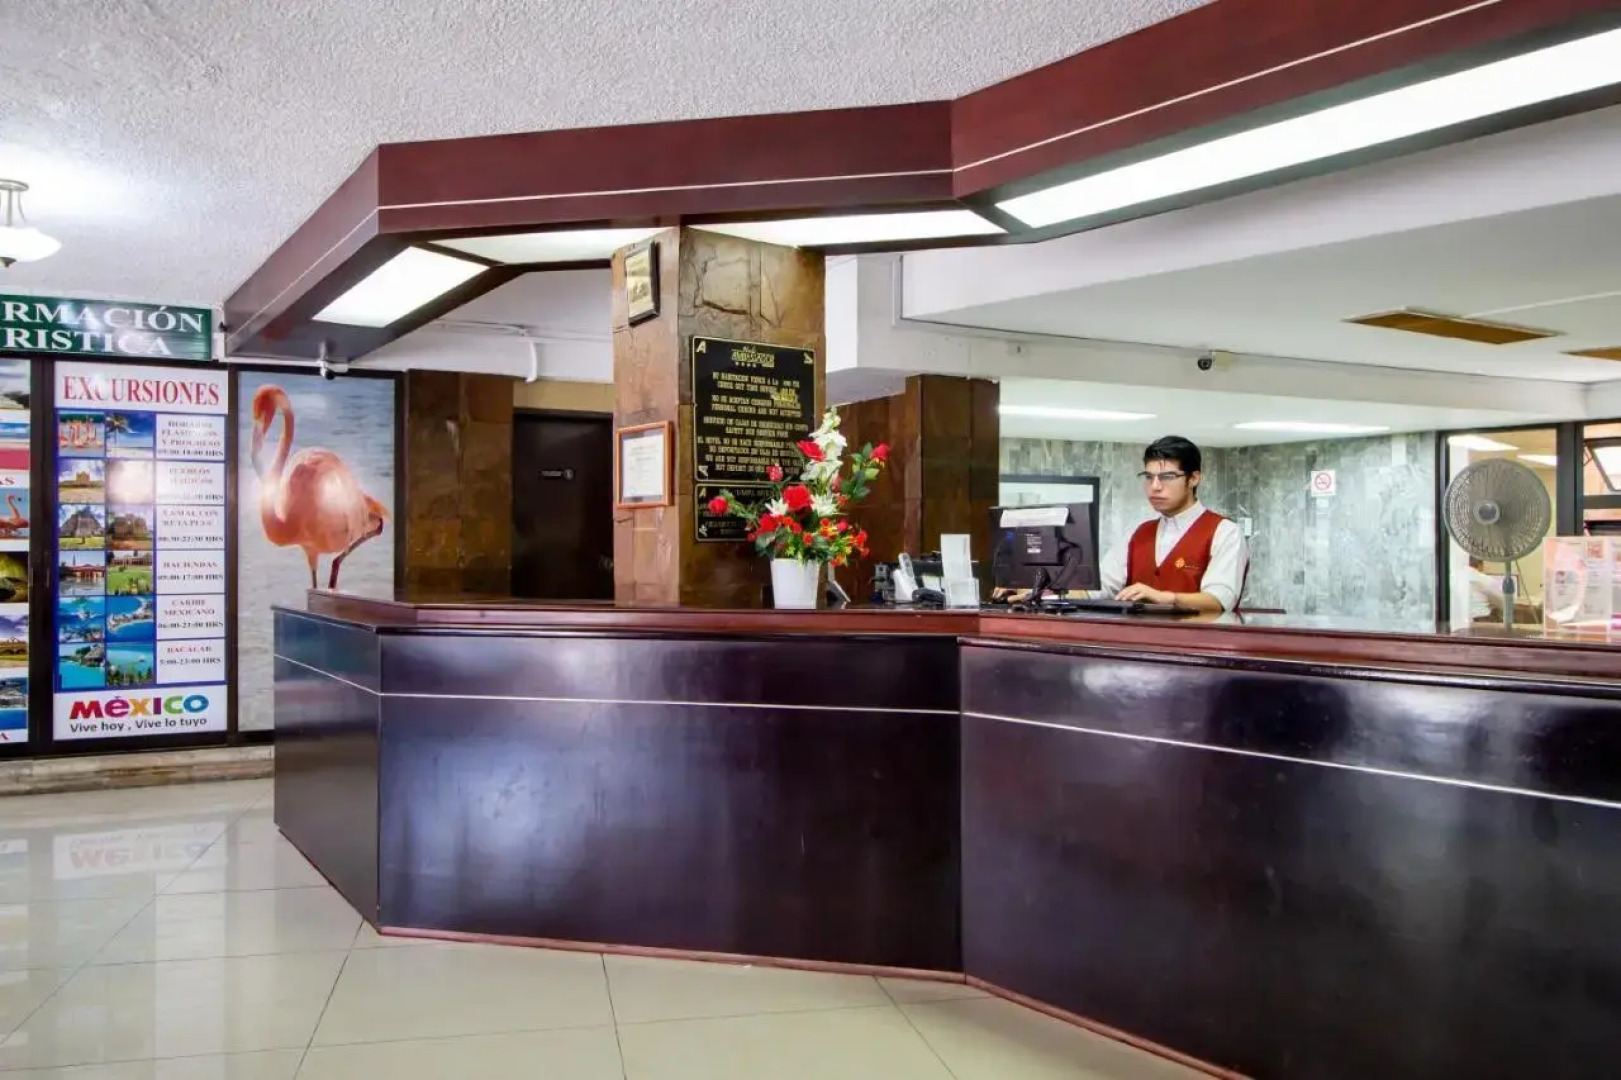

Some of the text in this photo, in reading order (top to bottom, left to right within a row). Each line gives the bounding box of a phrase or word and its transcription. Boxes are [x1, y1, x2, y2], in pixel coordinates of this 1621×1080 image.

[3, 301, 204, 333] RMACIÓN
[1, 327, 172, 356] RISTICA
[63, 376, 219, 405] EXCURSIONES
[70, 717, 207, 733] Vive hoy Vive lo tuyo
